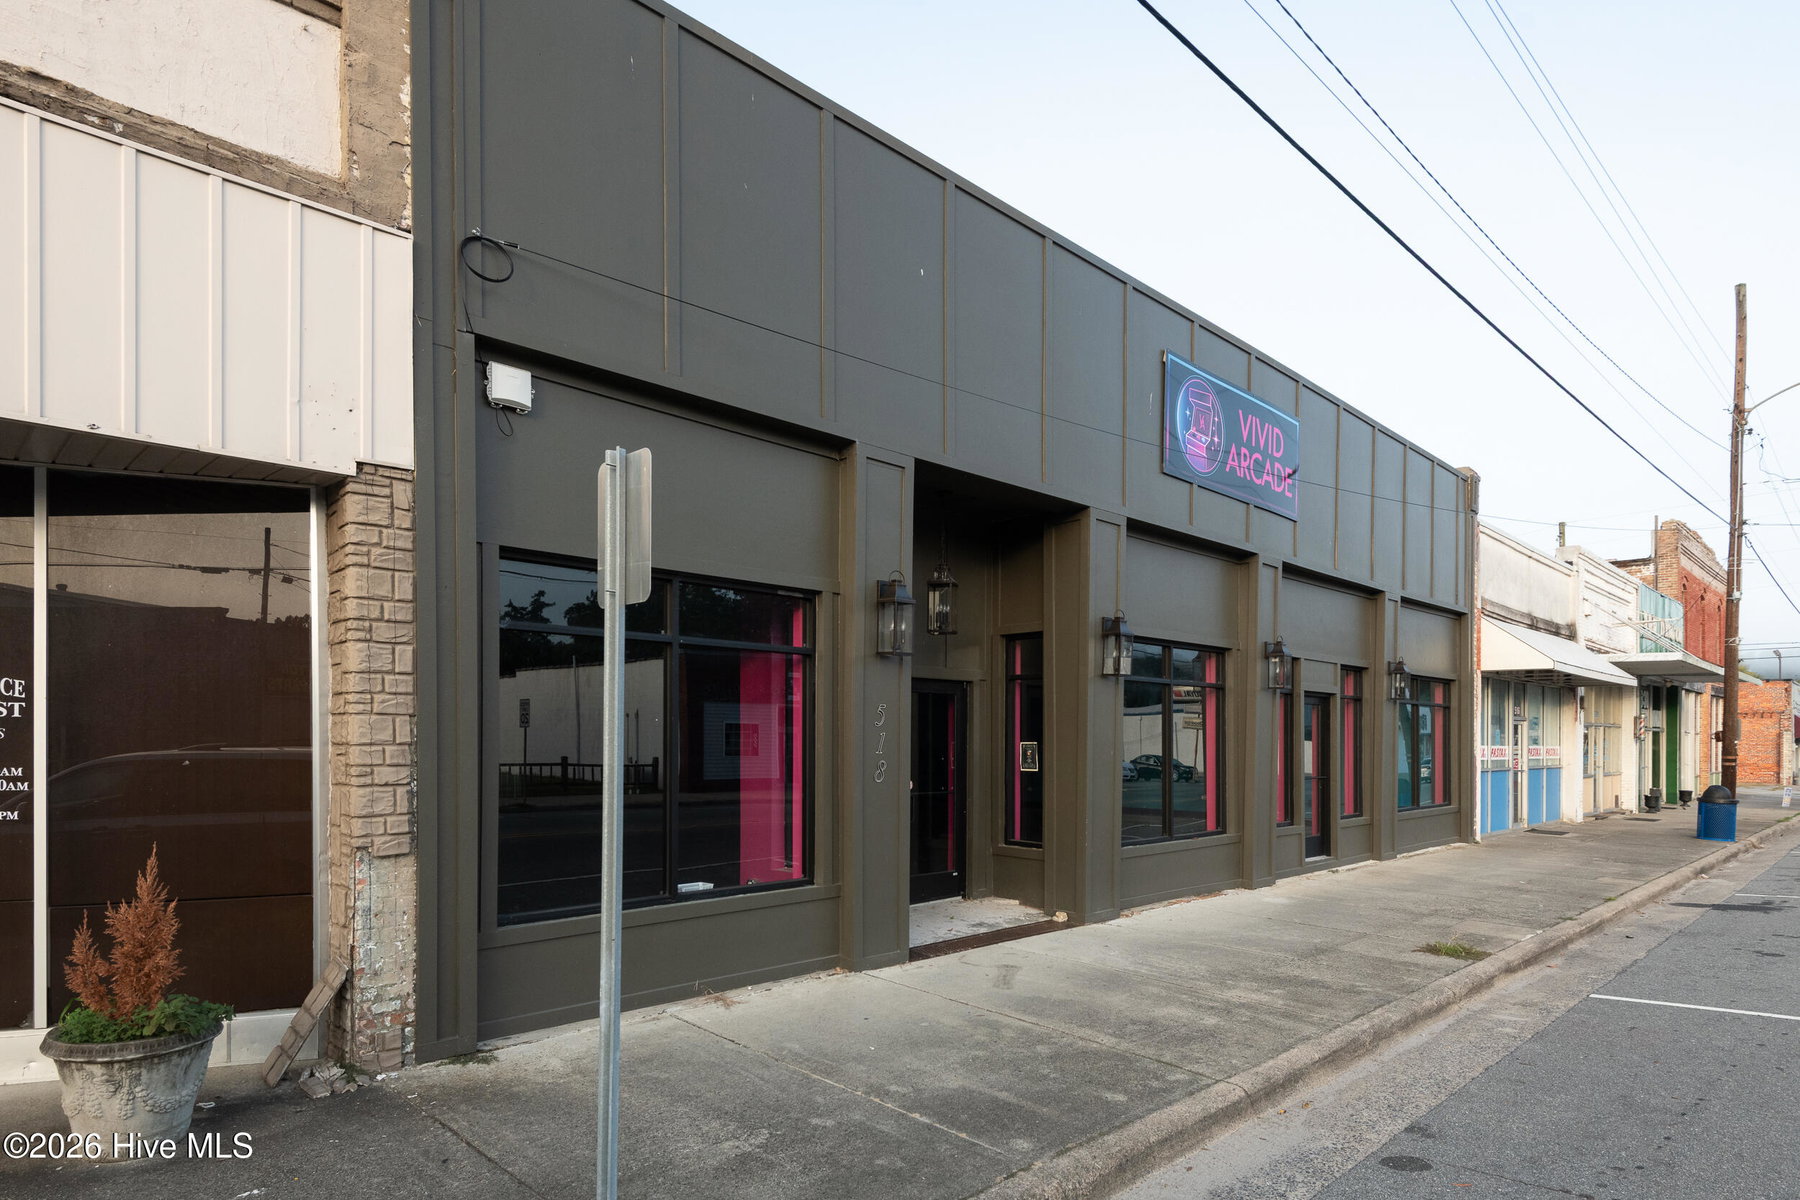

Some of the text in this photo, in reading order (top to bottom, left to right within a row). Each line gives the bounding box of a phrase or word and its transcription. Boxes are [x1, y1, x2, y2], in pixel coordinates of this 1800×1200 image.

[1239, 409, 1285, 458] VIVID
[1226, 443, 1293, 498] ARCADE
[874, 703, 887, 783] 518
